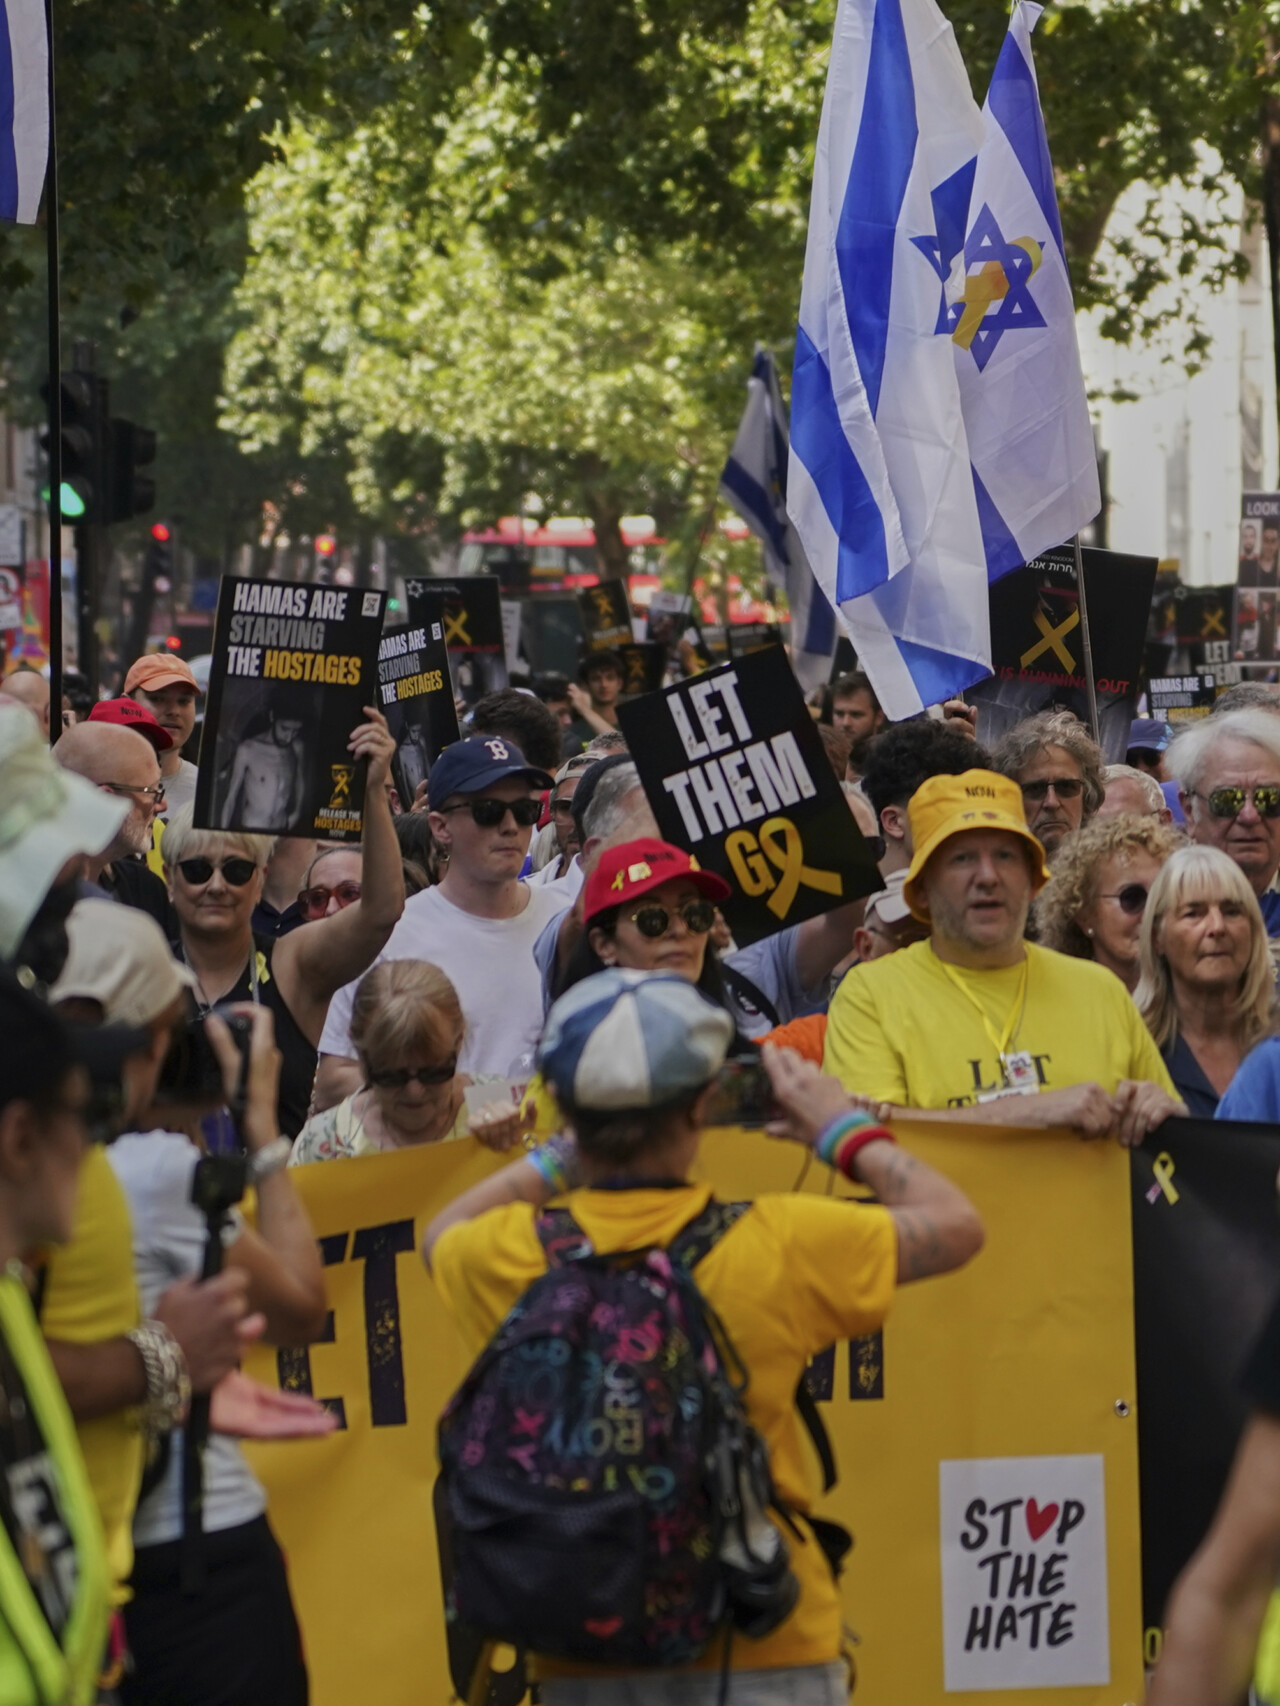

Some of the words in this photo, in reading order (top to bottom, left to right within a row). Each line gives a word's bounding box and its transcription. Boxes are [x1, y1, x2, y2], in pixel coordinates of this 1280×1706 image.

[1246, 501, 1279, 516] LOOK
[1048, 562, 1073, 573] חרות
[233, 582, 308, 618] HAMAS
[308, 589, 349, 622] ARE
[229, 613, 326, 650] STARVING
[408, 628, 427, 652] ARE
[227, 645, 262, 678] THE
[263, 649, 362, 686] HOSTAGES
[1204, 640, 1230, 663] LET
[378, 652, 420, 683] STARVING
[1000, 666, 1014, 680] IS
[1097, 678, 1130, 694] OUT
[380, 682, 397, 705] THE
[396, 669, 444, 700] HOSTAGES
[1150, 678, 1182, 694] HAMAS
[1183, 677, 1200, 692] ARE
[666, 670, 752, 762] LET
[484, 740, 510, 761] B
[662, 730, 817, 843] THEM
[314, 816, 361, 831] HOSTAGES
[977, 1550, 1069, 1600] THE
[963, 1600, 1077, 1653] HATE
